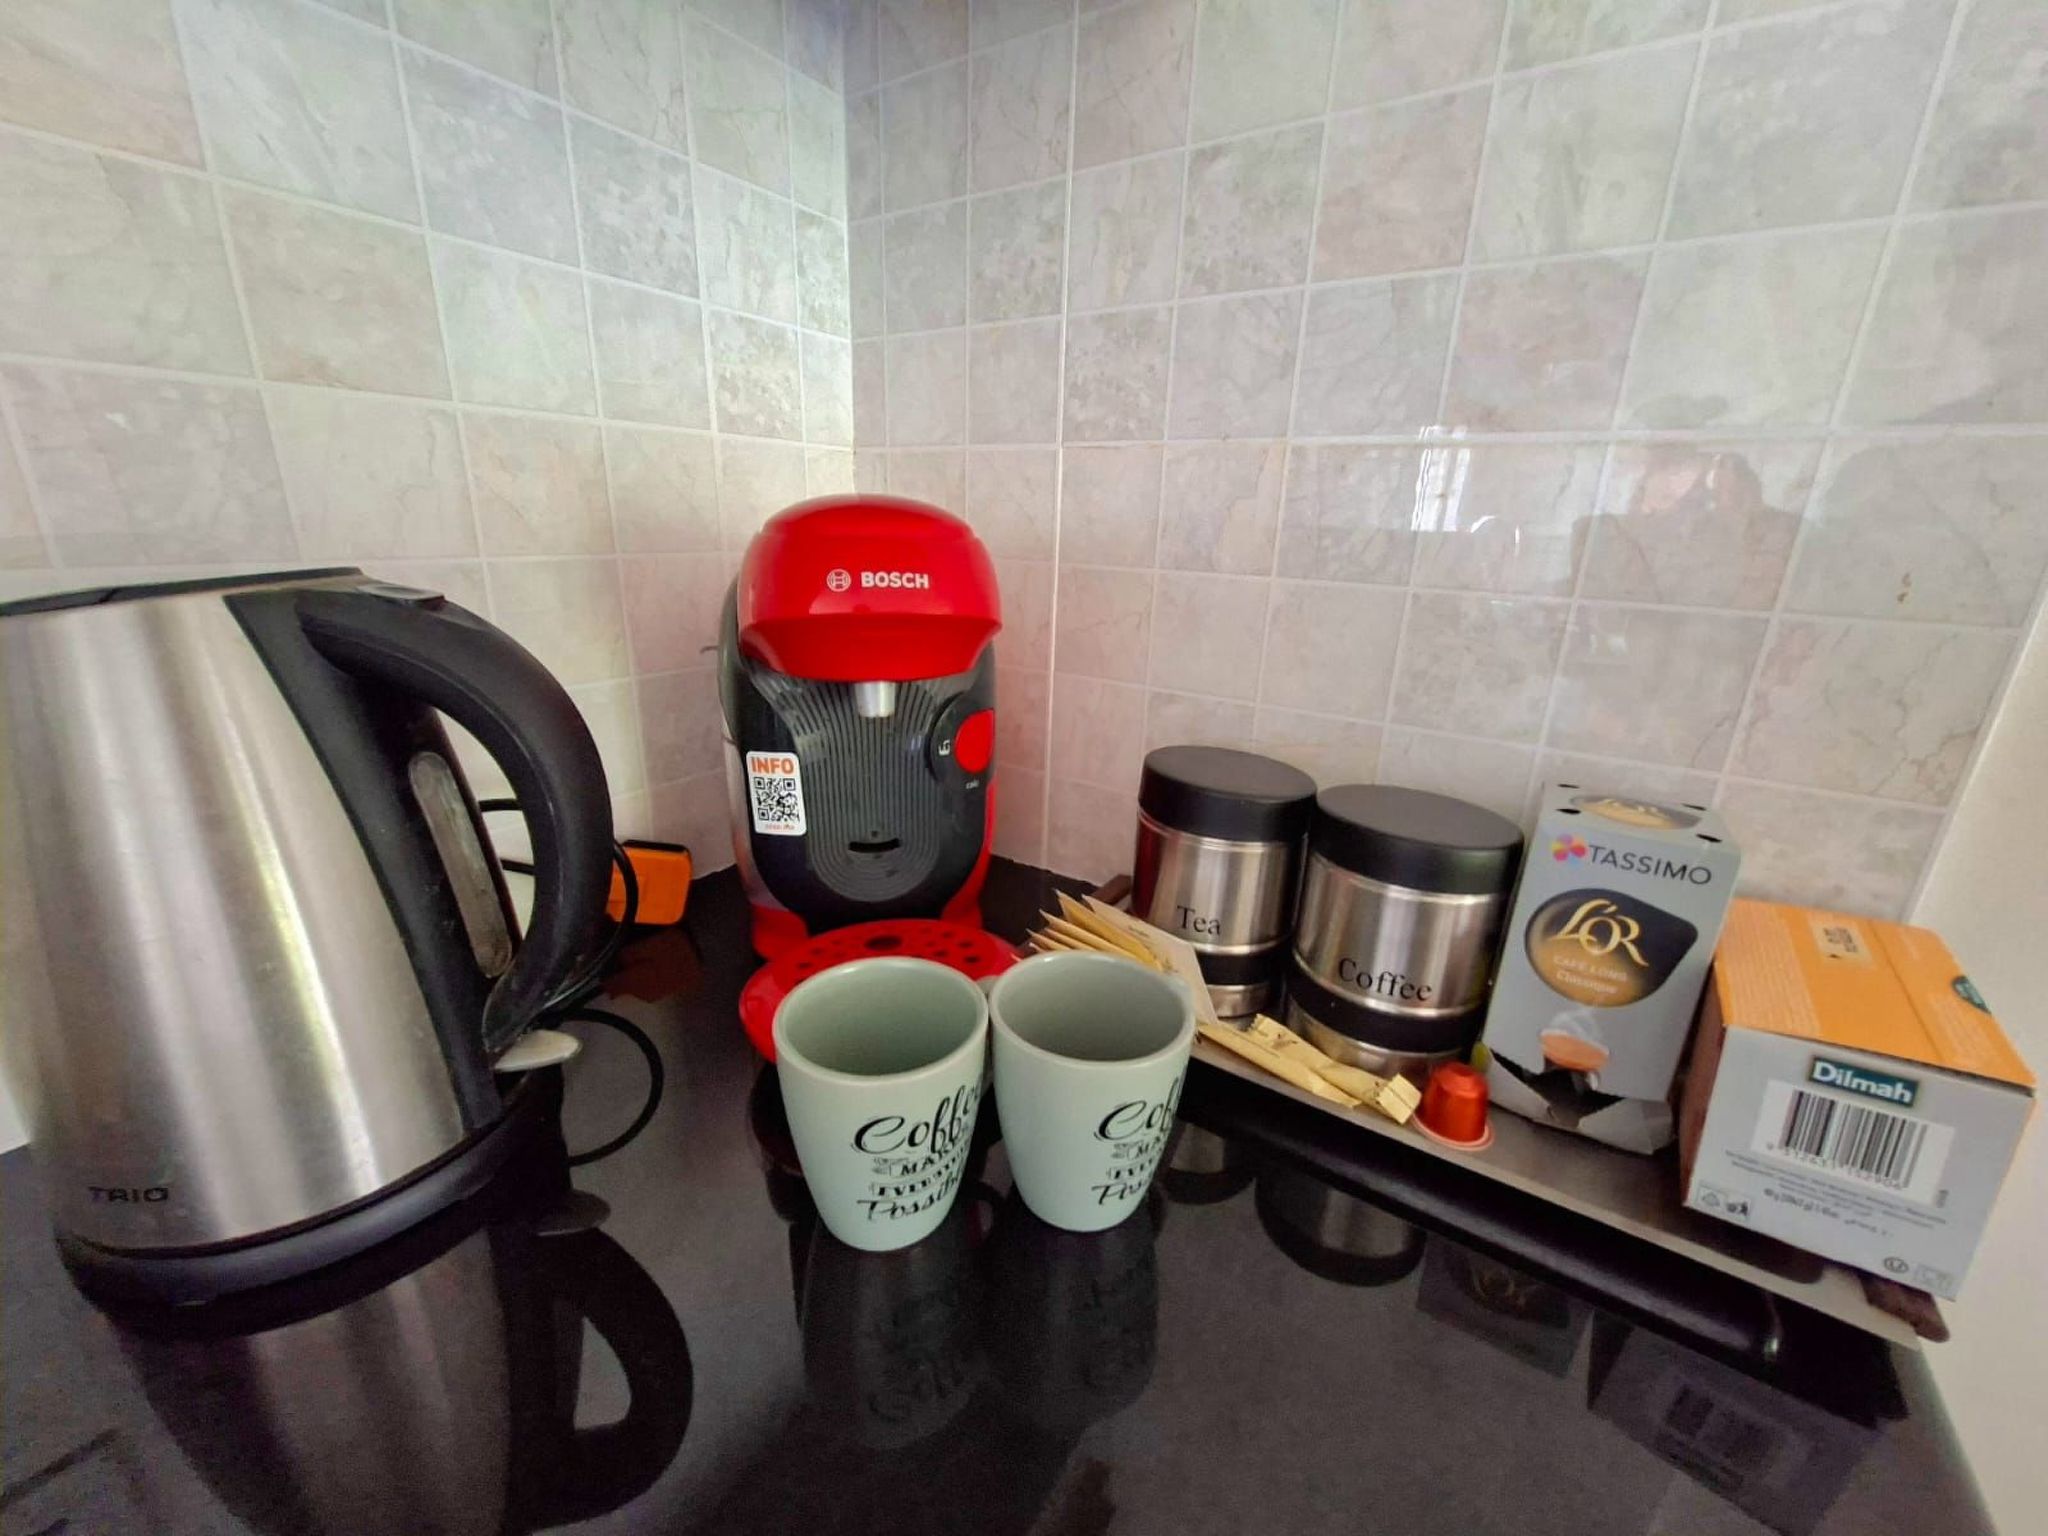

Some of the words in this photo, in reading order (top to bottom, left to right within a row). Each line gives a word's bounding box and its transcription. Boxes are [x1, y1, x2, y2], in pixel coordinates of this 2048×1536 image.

[860, 571, 930, 589] BOSCH
[751, 756, 795, 775] INFO
[1588, 844, 1712, 885] TASSIMO
[1176, 905, 1222, 936] Tea
[1337, 957, 1433, 1001] Coffee
[1811, 1060, 1913, 1104] Dilmah
[86, 1185, 170, 1203] TRIO
